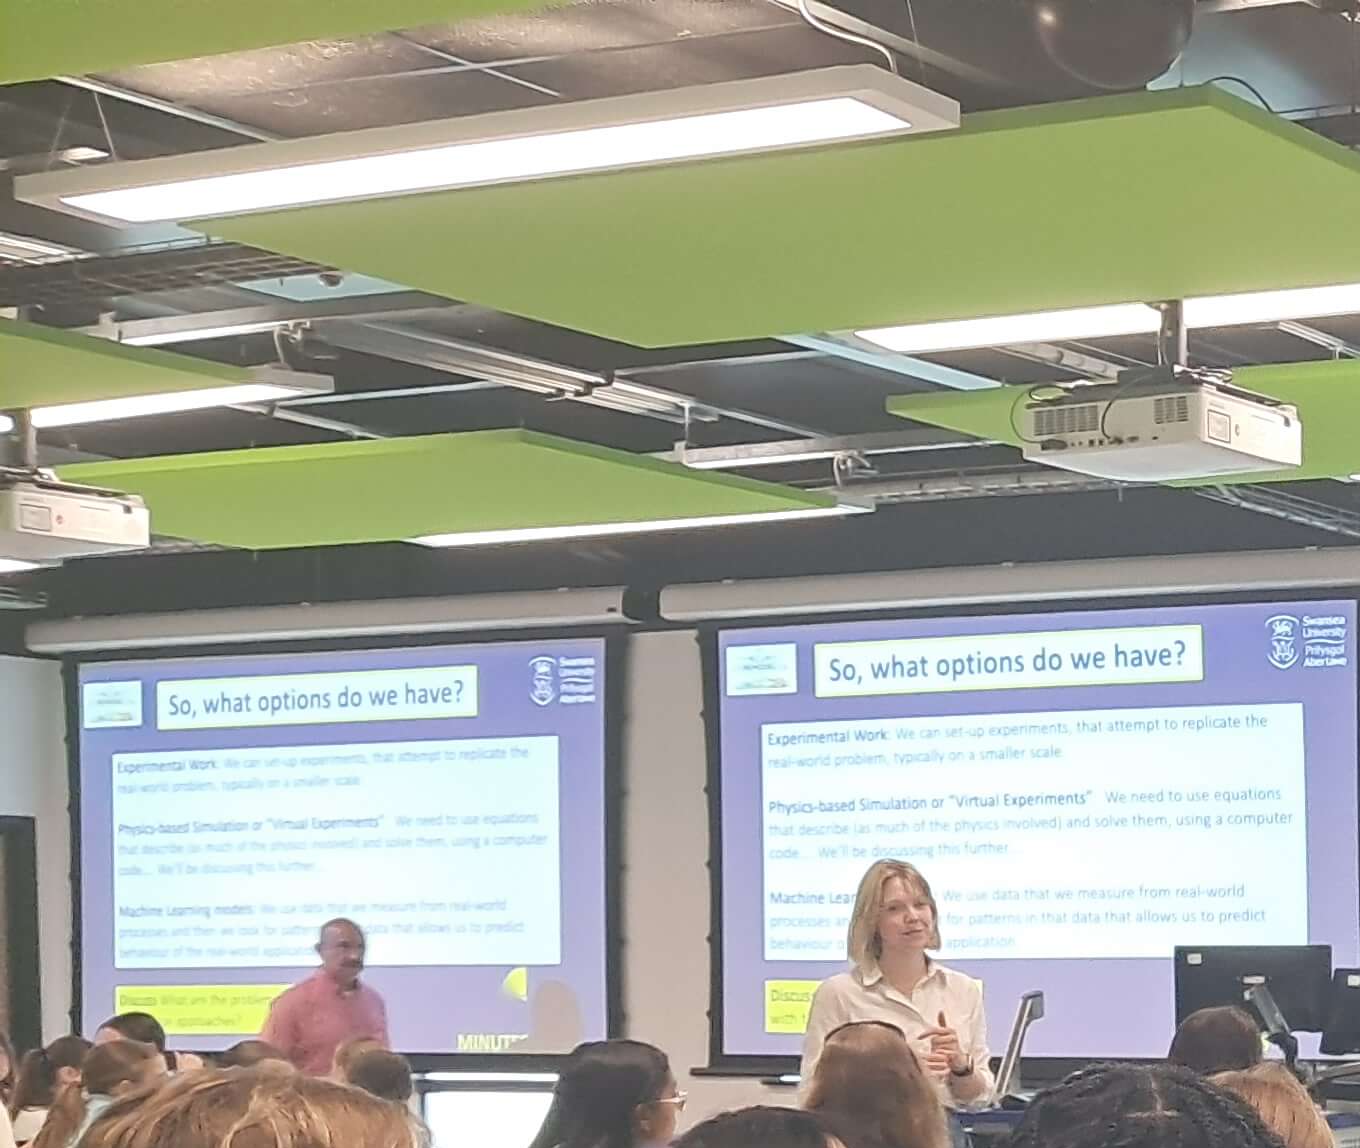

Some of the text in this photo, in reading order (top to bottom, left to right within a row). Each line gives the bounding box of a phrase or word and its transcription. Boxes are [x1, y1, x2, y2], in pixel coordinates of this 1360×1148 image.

[828, 638, 1186, 685] So, what options do we have?
[168, 678, 464, 718] So, what options do we have?
